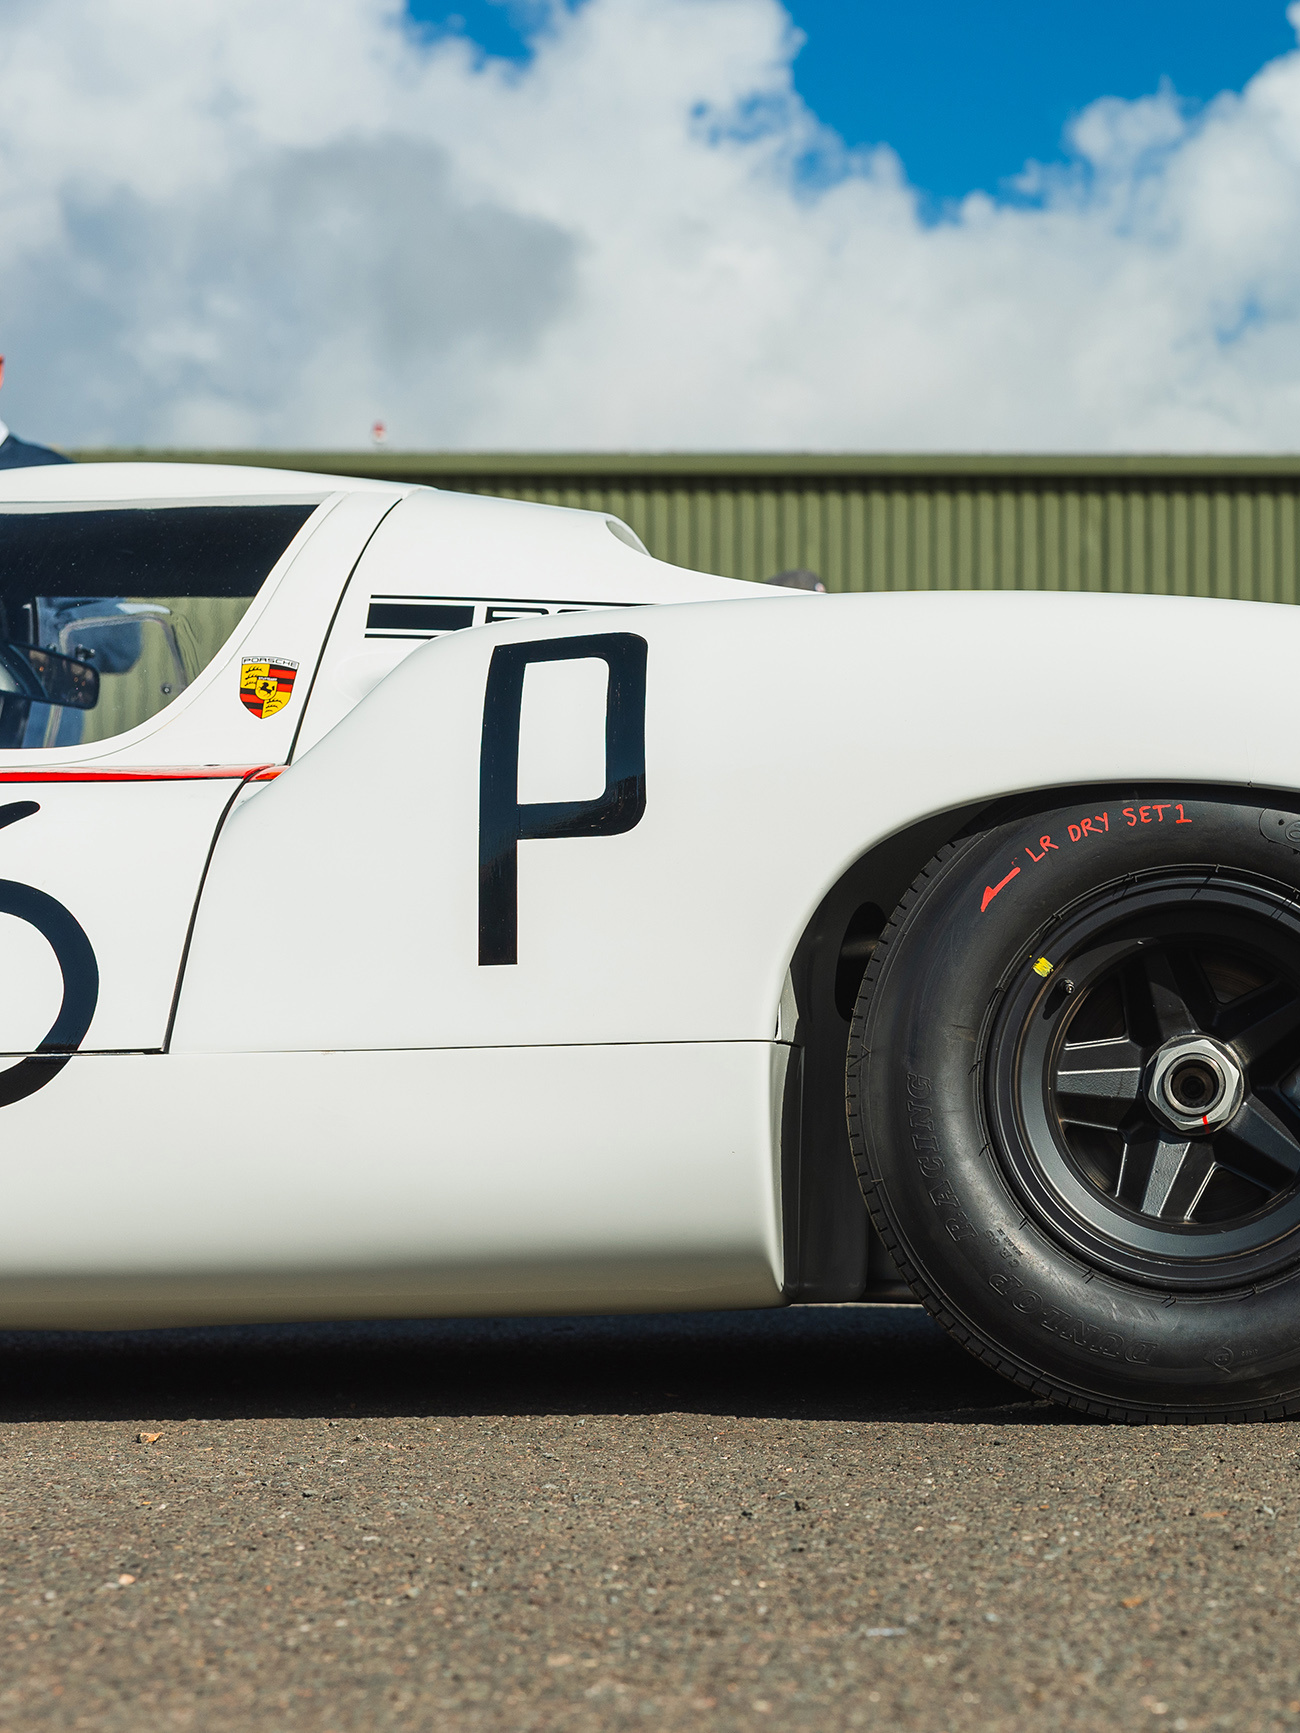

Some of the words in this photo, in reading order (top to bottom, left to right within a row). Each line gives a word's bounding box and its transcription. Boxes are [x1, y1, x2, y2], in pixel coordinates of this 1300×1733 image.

[243, 657, 297, 667] PORSCHE
[479, 632, 648, 965] P
[1025, 835, 1059, 862] LR
[1067, 812, 1109, 842] DRY
[906, 1072, 979, 1243] RACING
[987, 1272, 1159, 1365] DUNLOP
